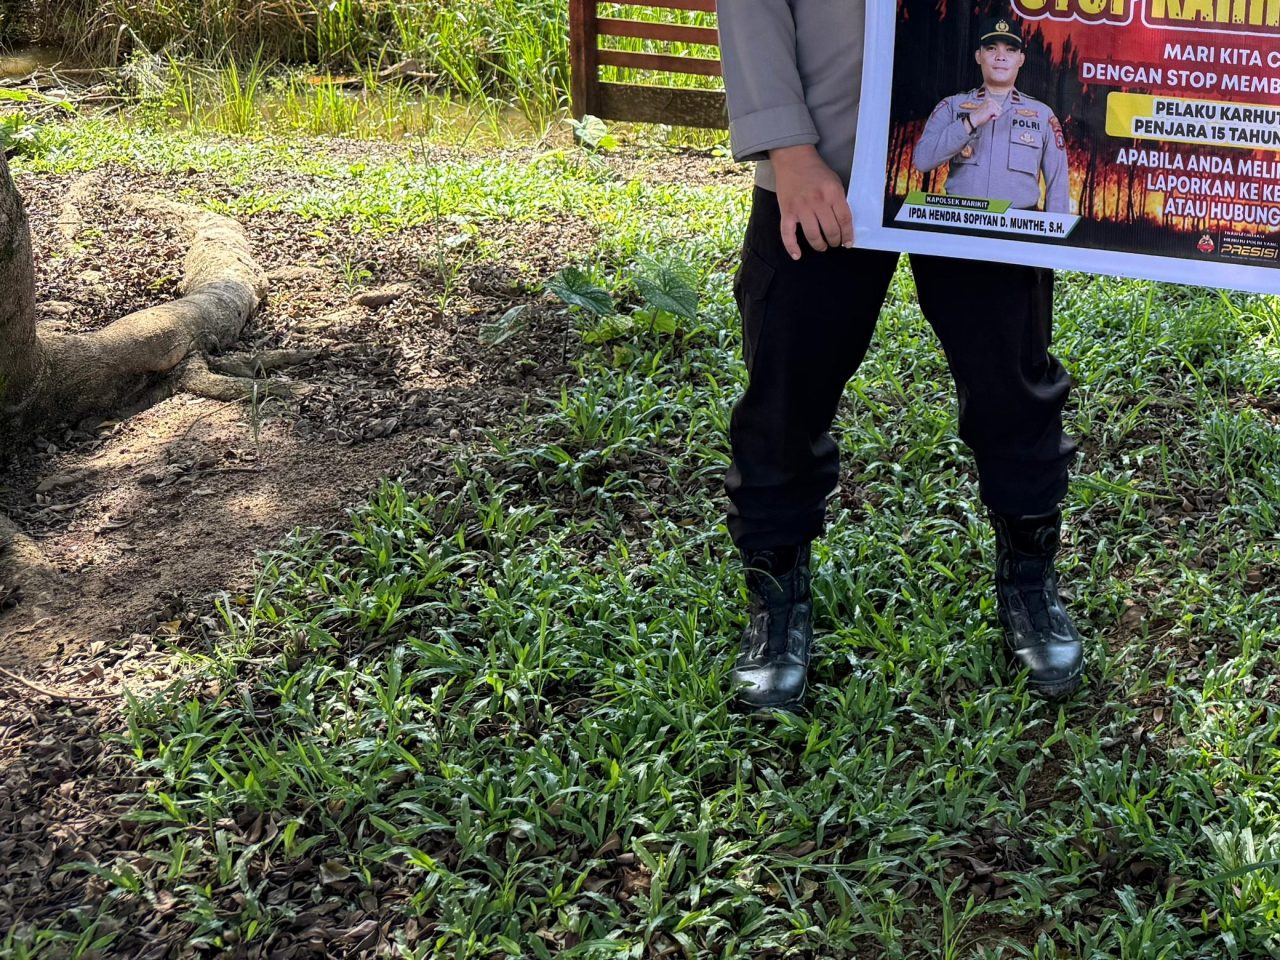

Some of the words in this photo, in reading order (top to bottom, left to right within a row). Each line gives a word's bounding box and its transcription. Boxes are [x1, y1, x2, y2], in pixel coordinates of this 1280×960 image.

[1164, 43, 1215, 63] MARI
[1220, 46, 1263, 67] KITA
[1082, 62, 1163, 85] DENGAN
[1167, 70, 1218, 89] STOP
[1155, 102, 1216, 119] PELAKU
[1012, 119, 1040, 130] POLRI
[1134, 119, 1208, 139] PENJARA
[1211, 126, 1225, 140] 15
[1116, 148, 1184, 170] APABILA
[1187, 155, 1234, 175] ANDA
[1147, 174, 1235, 198] LAPORKAN
[1239, 183, 1259, 200] KE
[926, 196, 960, 206] KAPOLSEK
[961, 200, 988, 209] MARIKIT
[1165, 198, 1207, 218] ATAU
[908, 207, 927, 219] IPDA
[928, 209, 962, 223] HENDRA
[963, 213, 998, 227] SOPIYAN
[1000, 217, 1008, 228] D.
[1010, 218, 1047, 234] MUNTHE,
[1048, 222, 1065, 233] S.H.
[1221, 243, 1279, 259] PRESISI
